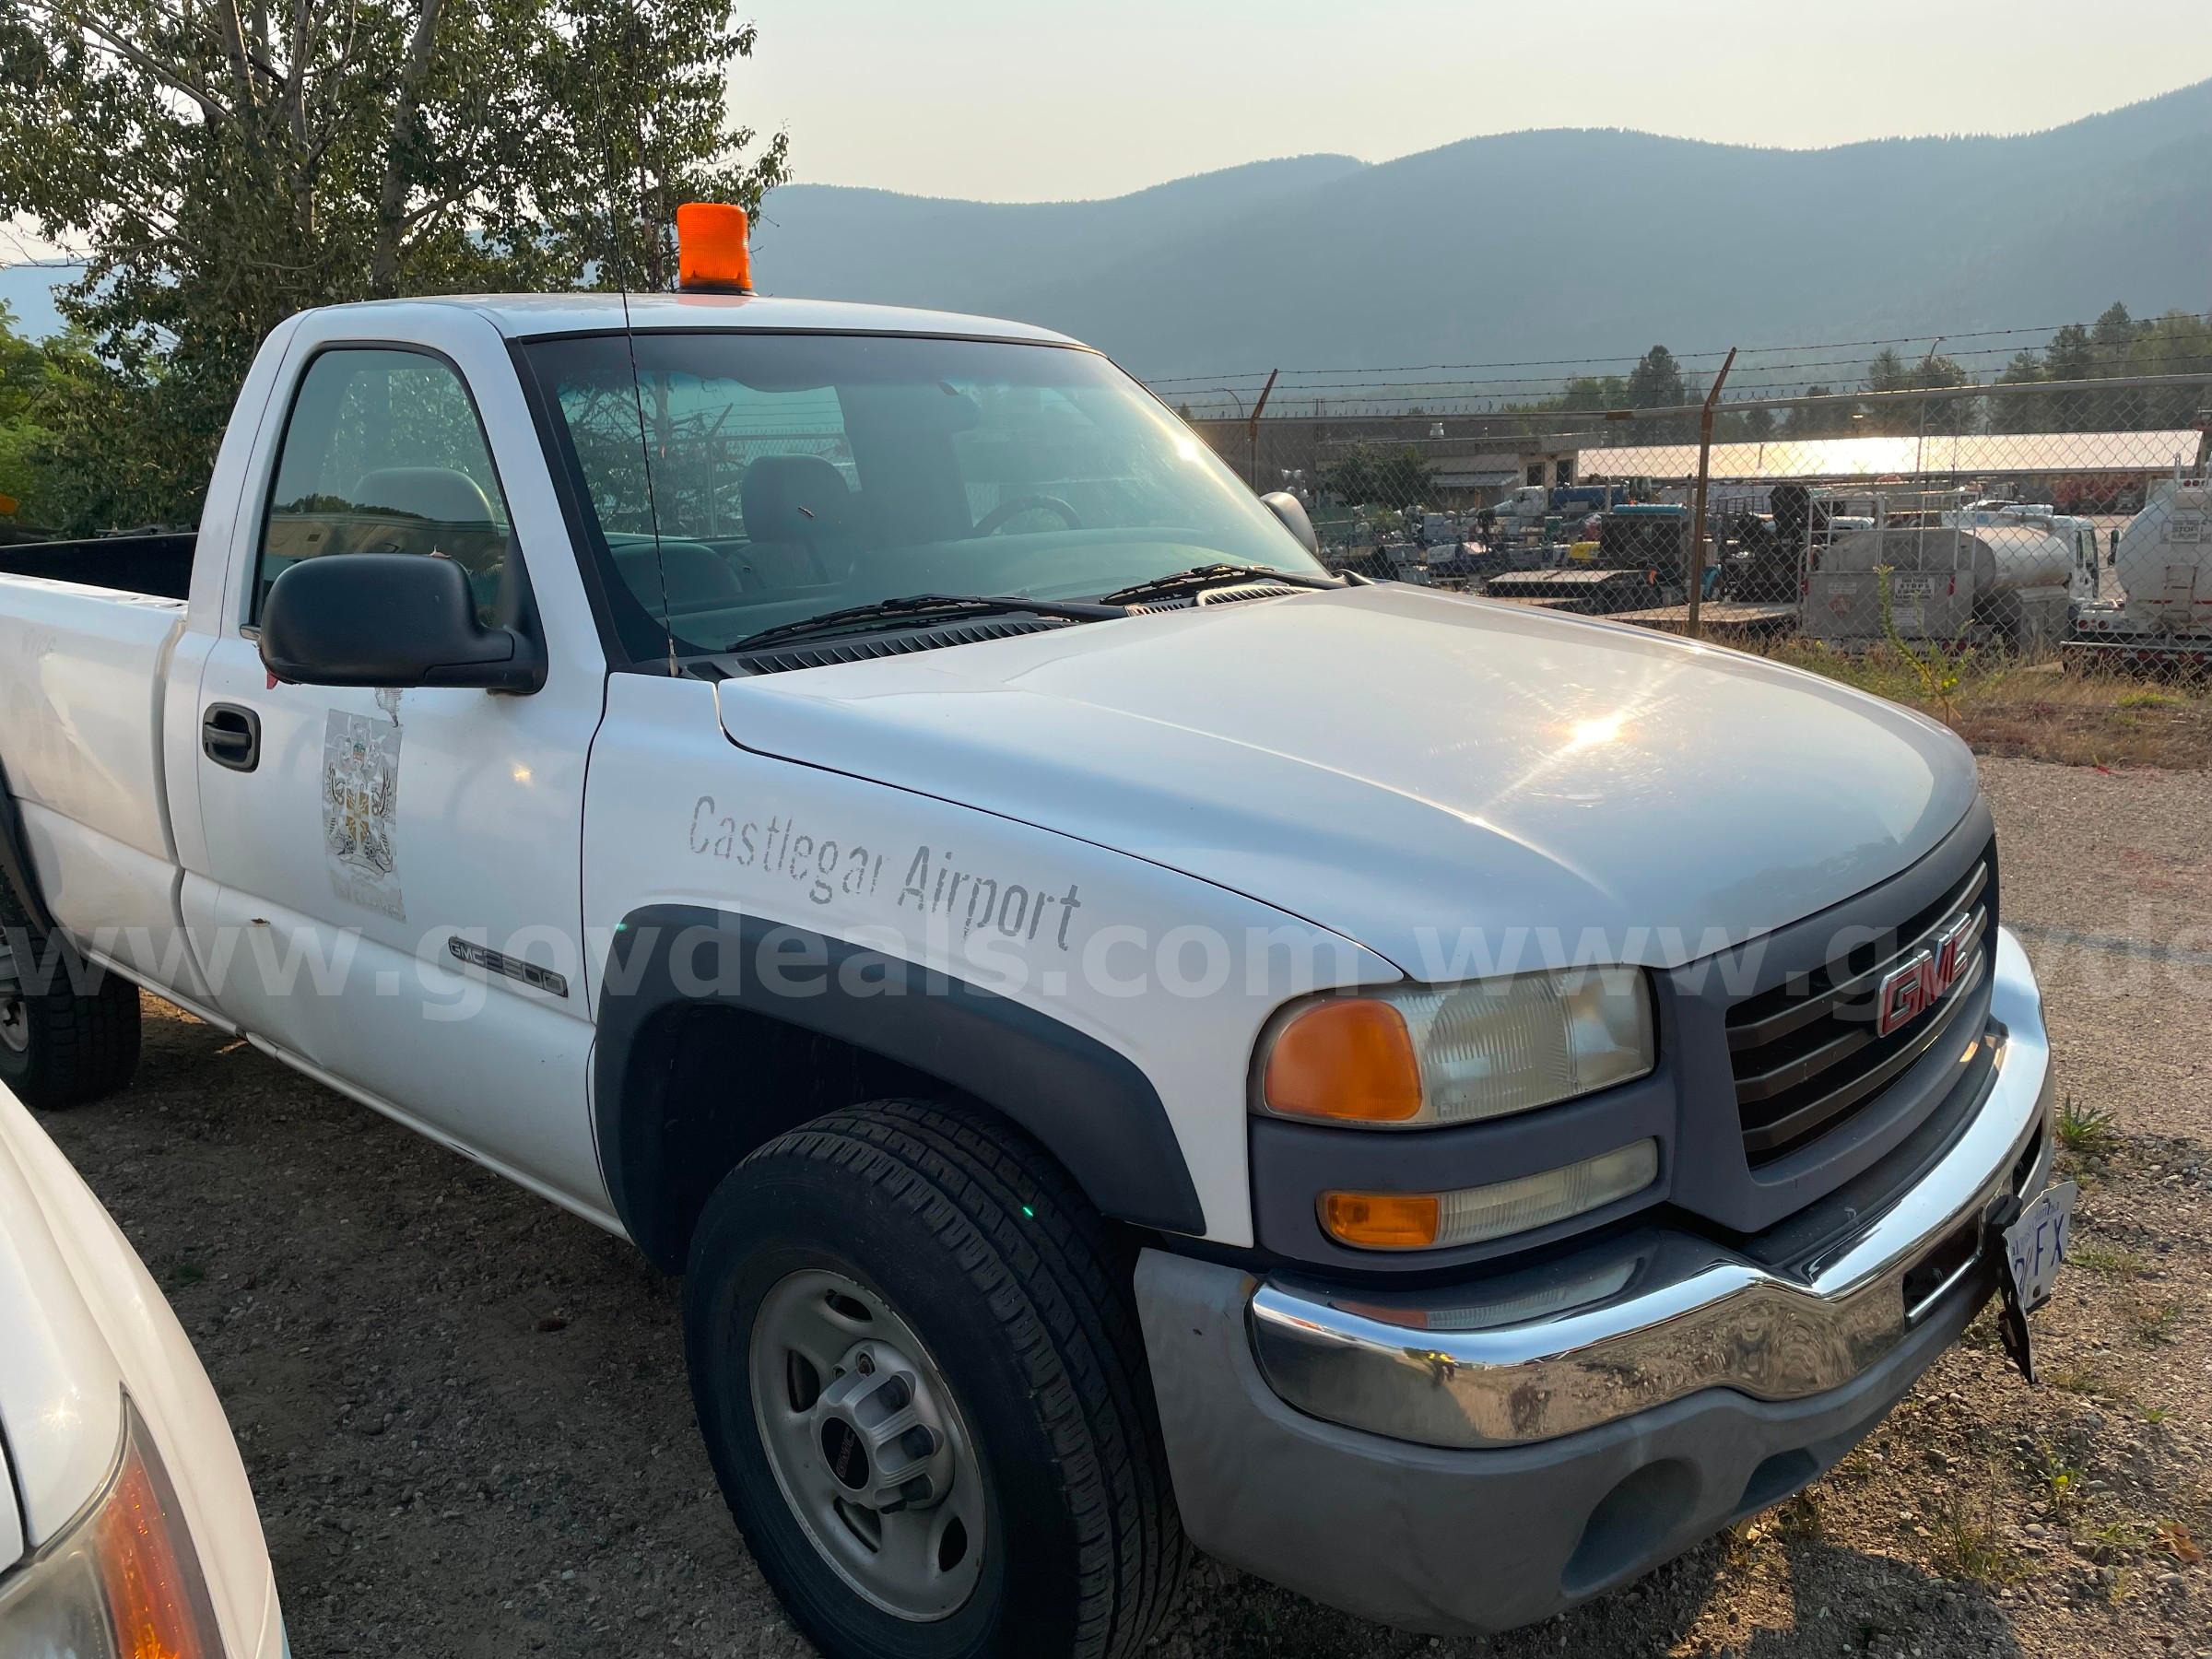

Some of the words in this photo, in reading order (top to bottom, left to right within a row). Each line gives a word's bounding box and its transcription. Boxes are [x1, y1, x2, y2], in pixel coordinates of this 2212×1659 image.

[688, 795, 883, 905] Castlegar
[898, 845, 1081, 951] Airport
[450, 942, 483, 966] GMC
[1877, 911, 1971, 1039] GMC
